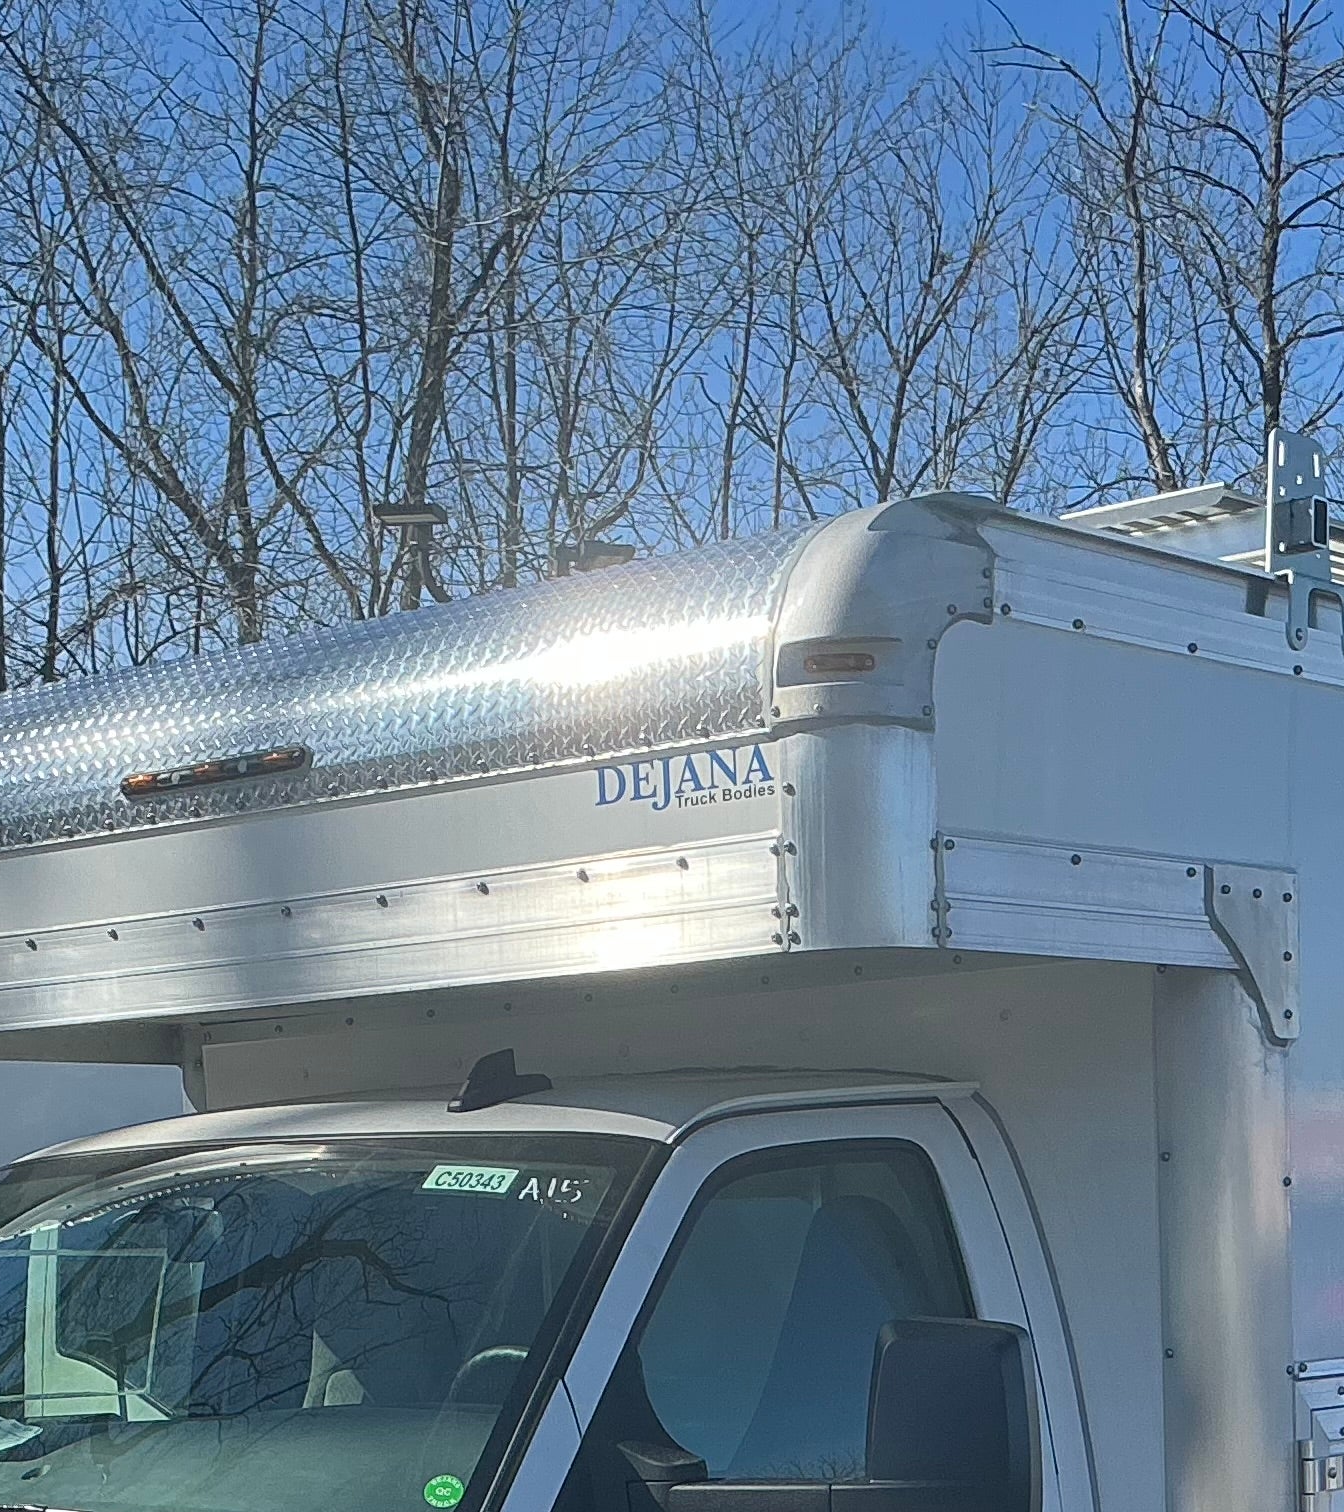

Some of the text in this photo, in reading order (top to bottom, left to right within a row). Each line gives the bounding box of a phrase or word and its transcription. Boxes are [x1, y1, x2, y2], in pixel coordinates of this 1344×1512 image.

[595, 743, 775, 811] DEJANA
[675, 784, 776, 809] Truck Bodies
[434, 1171, 506, 1190] C50343
